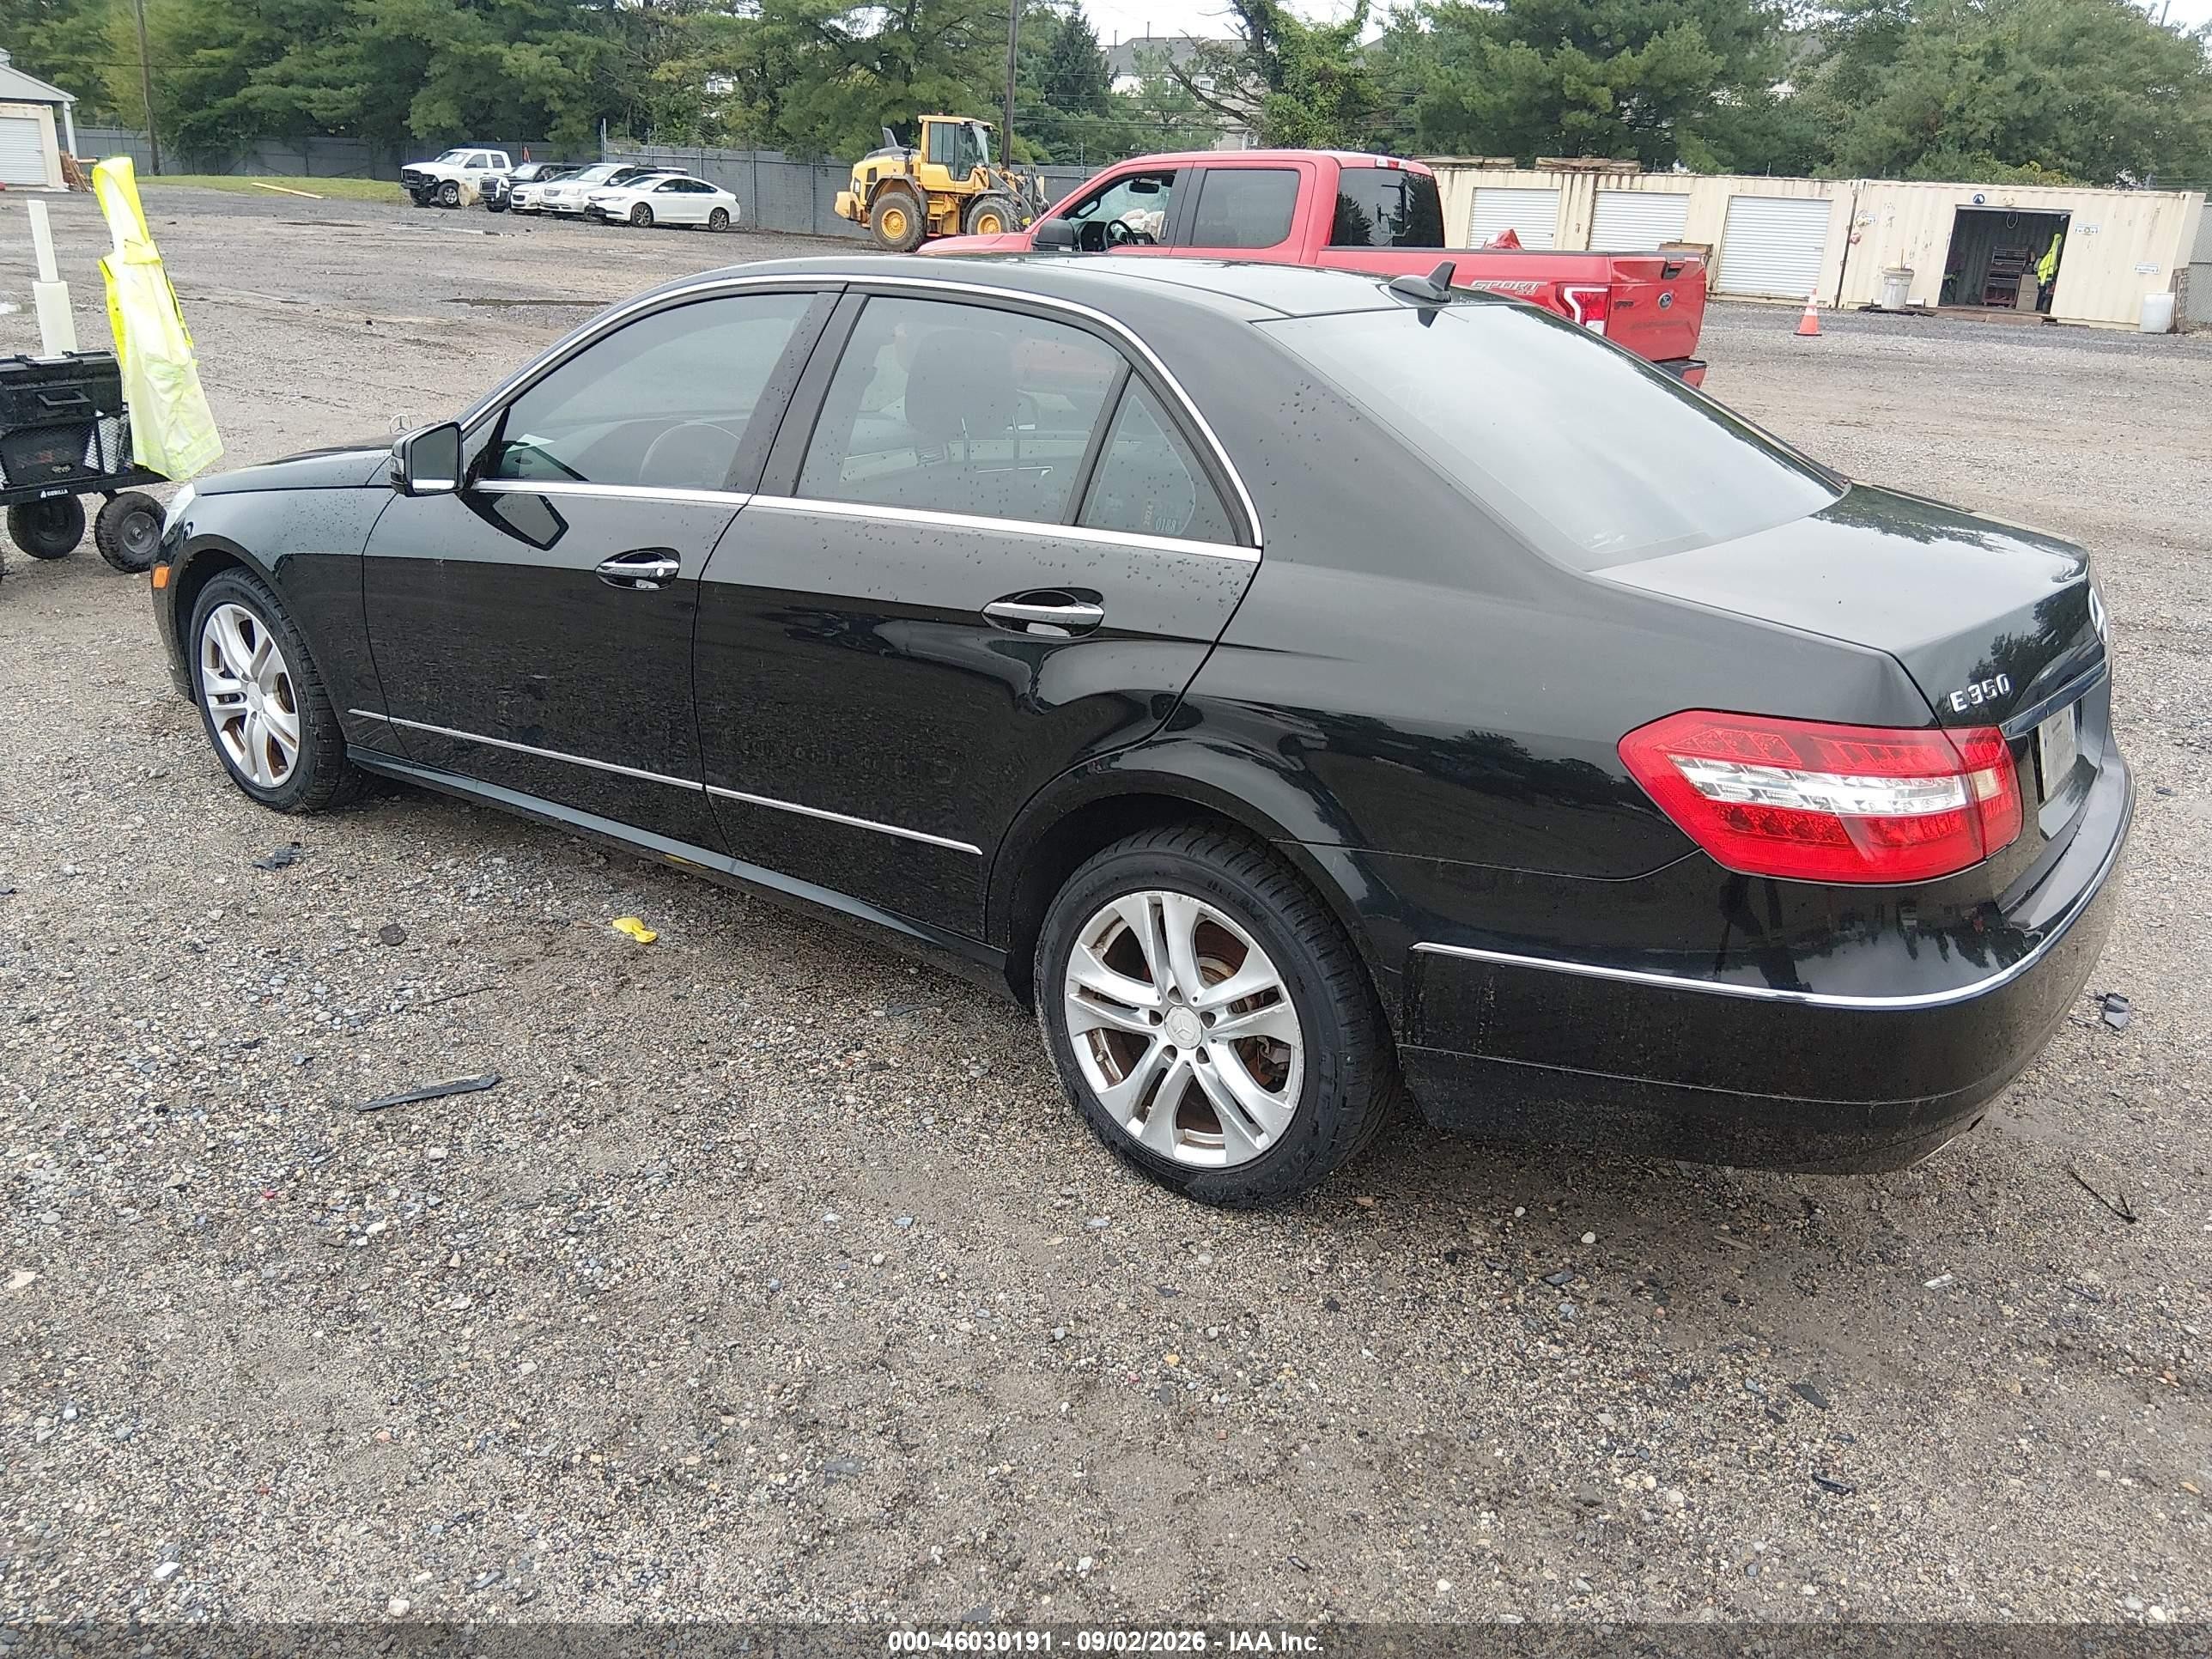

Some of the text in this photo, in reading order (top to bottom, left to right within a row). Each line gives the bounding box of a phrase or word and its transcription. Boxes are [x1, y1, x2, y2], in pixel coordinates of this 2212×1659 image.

[1470, 280, 1547, 290] SPORT
[1949, 673, 2011, 713] E 350
